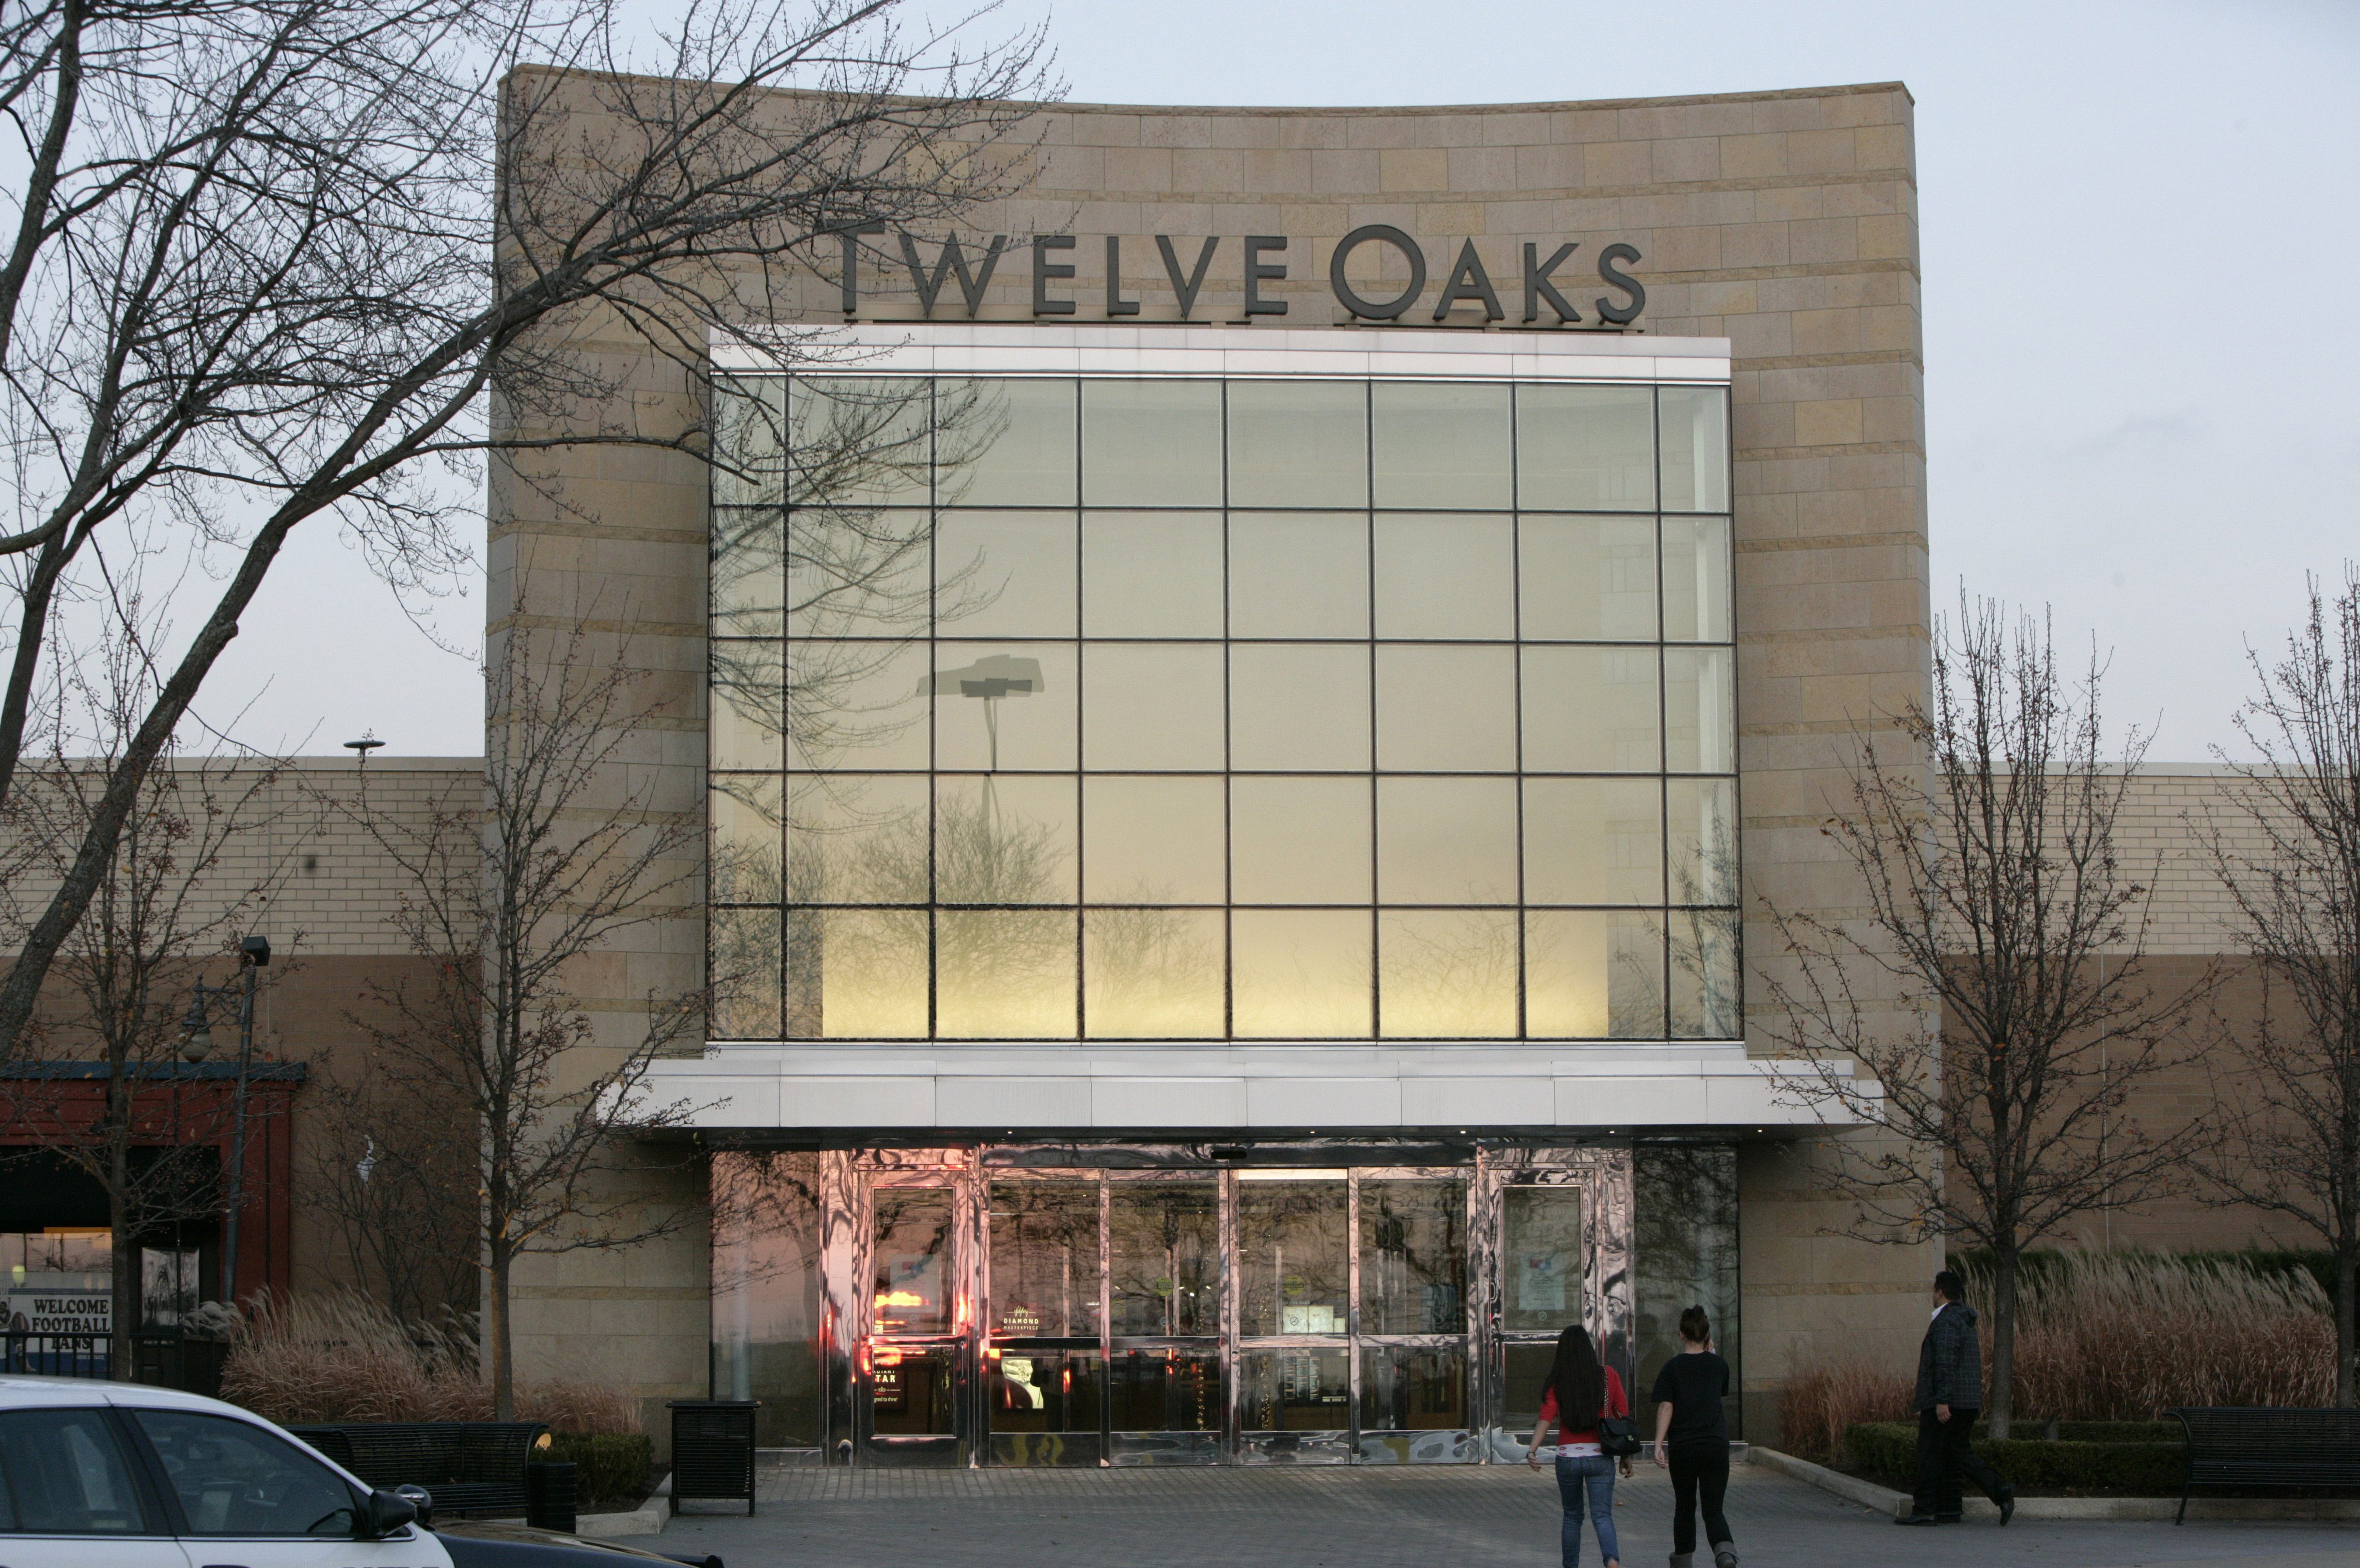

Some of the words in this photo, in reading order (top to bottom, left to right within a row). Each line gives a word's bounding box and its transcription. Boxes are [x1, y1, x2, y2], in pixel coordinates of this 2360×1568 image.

[815, 218, 1288, 321] TWELVE
[1330, 224, 1646, 324] OAKS
[34, 1299, 109, 1314] WELCOME
[32, 1317, 110, 1332] FOOTBALL
[875, 1374, 896, 1382] TAR
